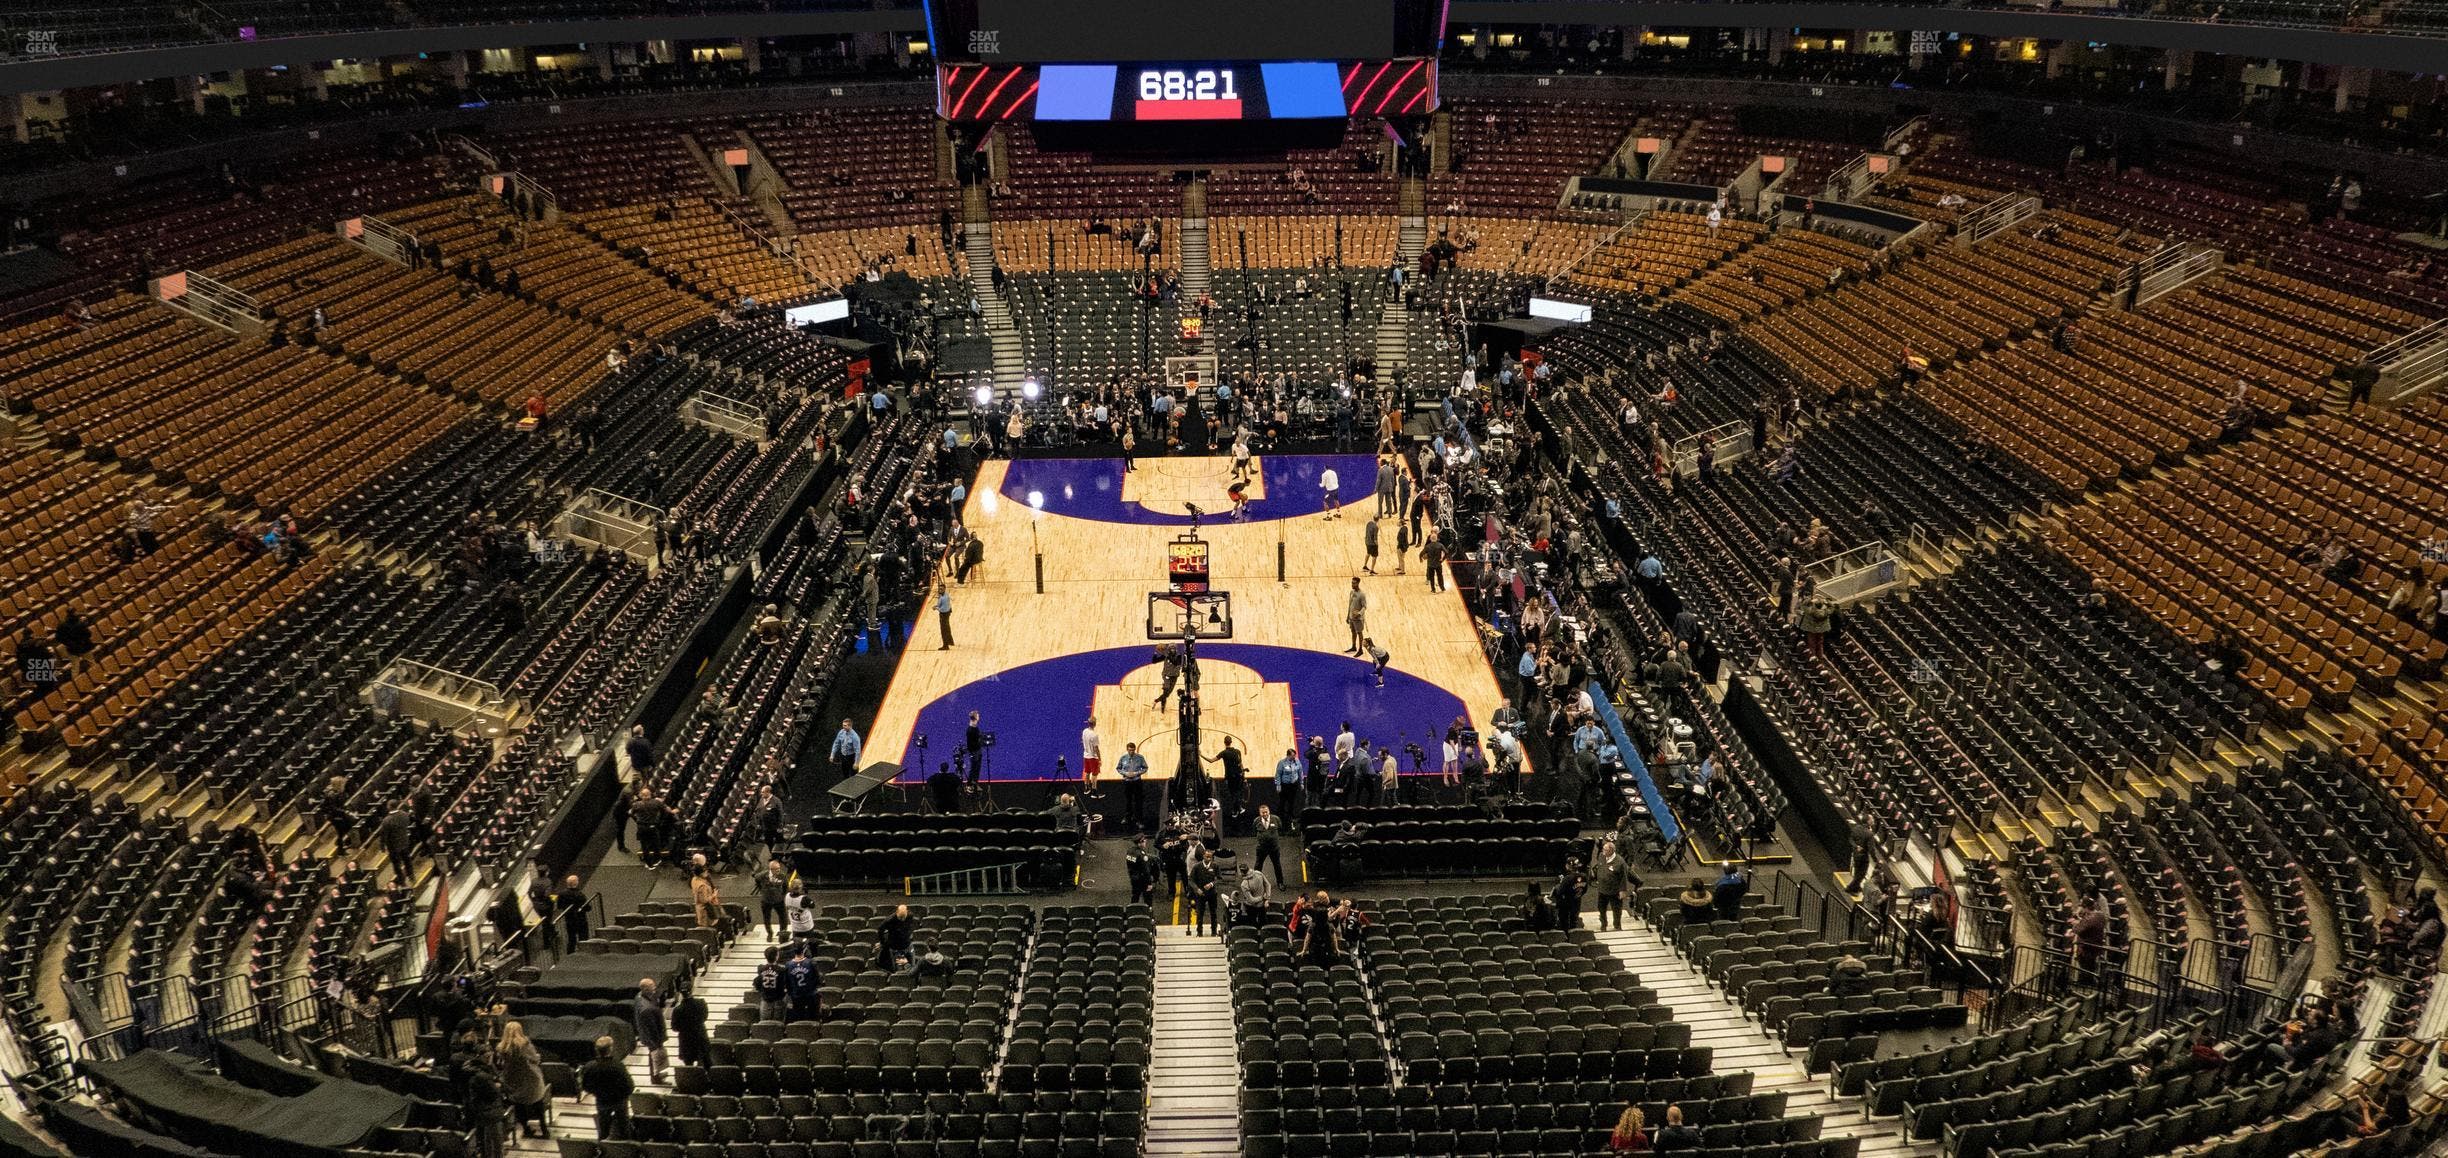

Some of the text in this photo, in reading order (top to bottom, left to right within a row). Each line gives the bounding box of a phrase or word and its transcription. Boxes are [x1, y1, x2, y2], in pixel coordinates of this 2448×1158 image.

[1140, 71, 1238, 100] 68:21
[1184, 326, 1199, 338] 24
[1177, 556, 1200, 572] 24
[1231, 912, 1237, 922] 2
[1347, 920, 1355, 930] 2
[762, 976, 777, 989] 23
[796, 974, 807, 987] 2
